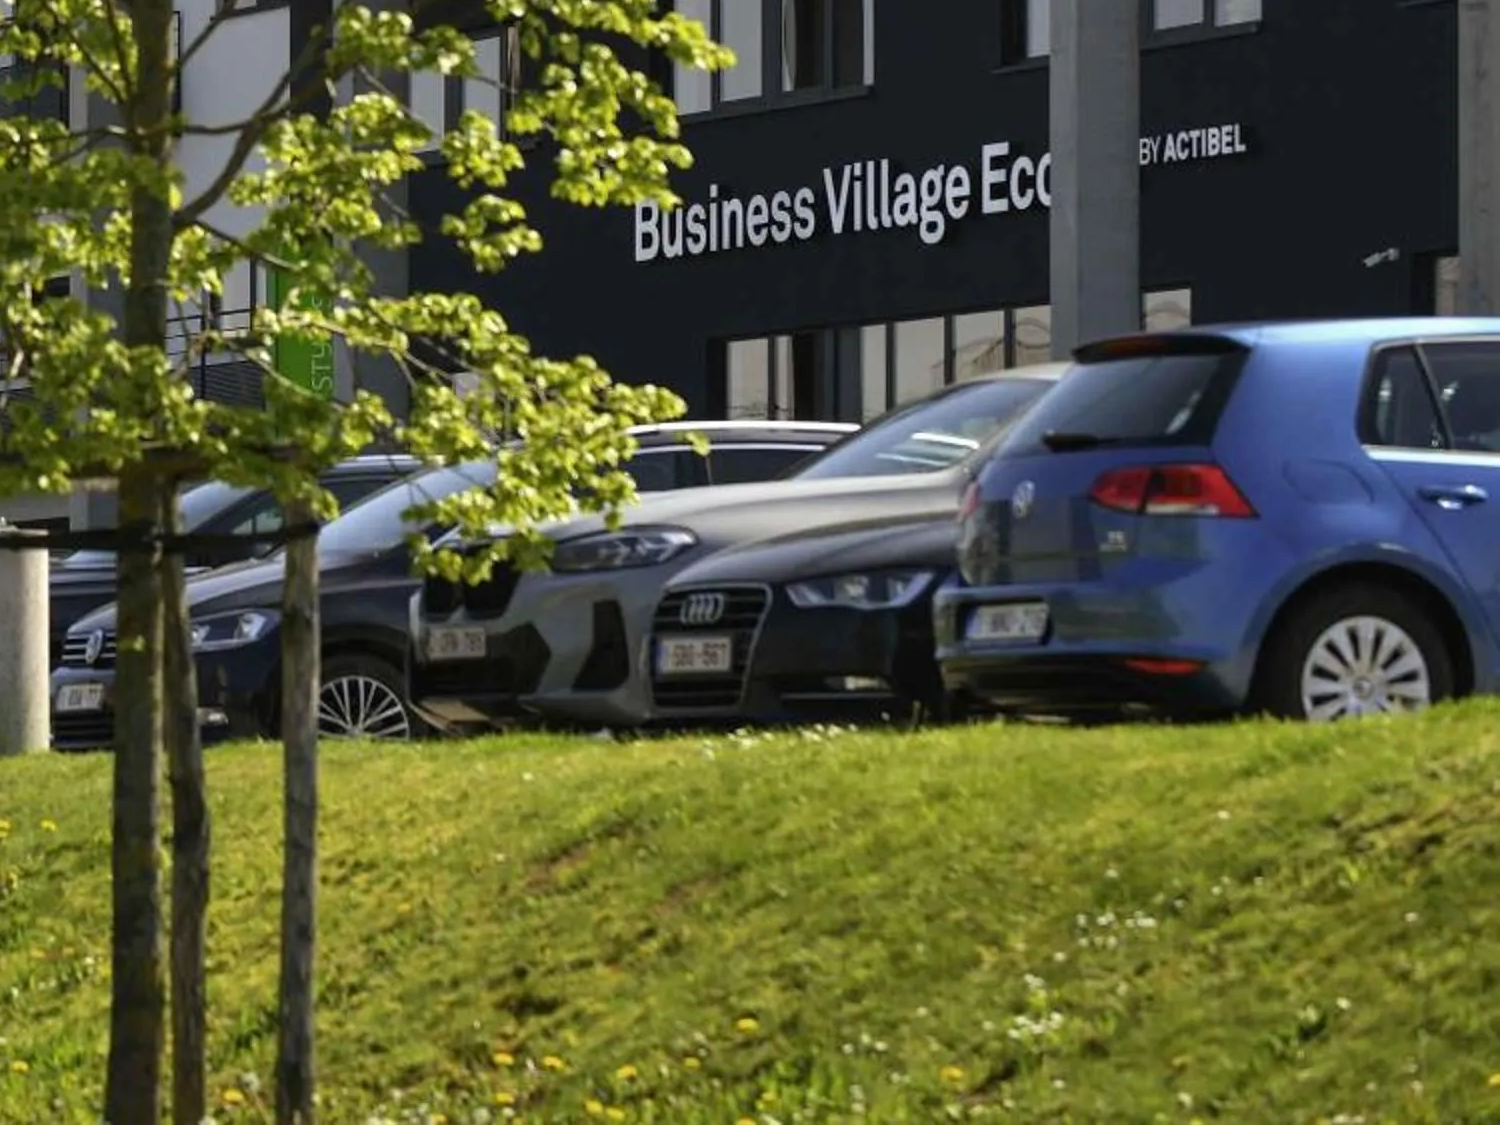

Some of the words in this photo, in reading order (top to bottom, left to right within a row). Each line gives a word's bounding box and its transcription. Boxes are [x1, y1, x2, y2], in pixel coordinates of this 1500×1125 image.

[1139, 135, 1161, 165] BY
[1163, 123, 1246, 162] ACTIBEL
[635, 184, 815, 262] Business
[823, 159, 971, 244] Village
